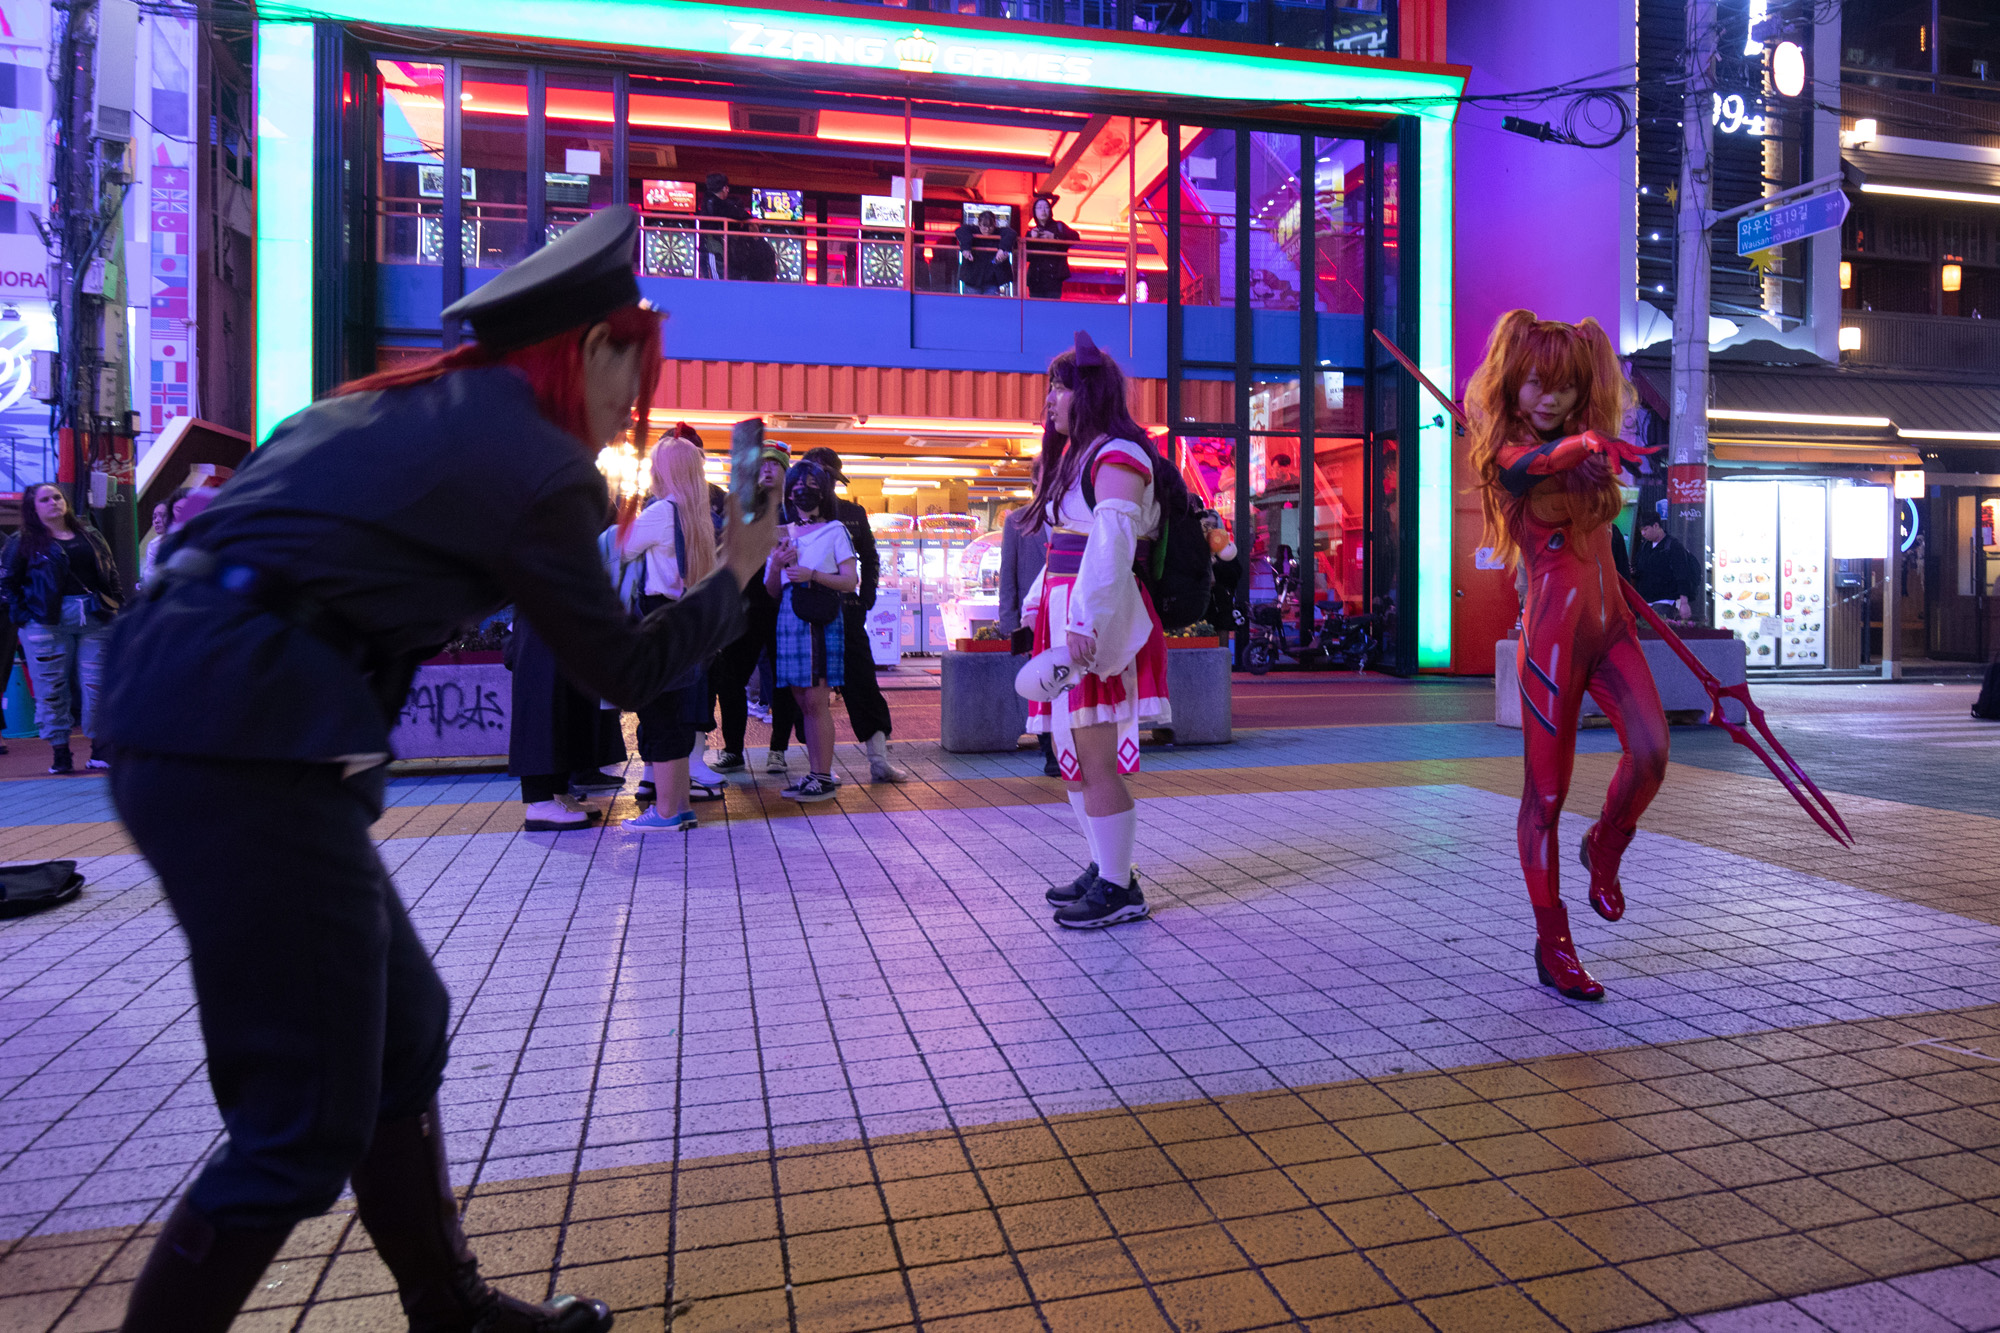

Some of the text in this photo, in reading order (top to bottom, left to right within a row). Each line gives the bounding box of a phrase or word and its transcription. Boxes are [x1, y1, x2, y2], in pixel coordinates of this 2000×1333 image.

[728, 20, 1093, 83] ZZANG GAMES
[1741, 203, 1808, 236] 와우산로19길
[1741, 224, 1805, 251] Wausan-ro 19-gil
[0, 271, 48, 288] ORA
